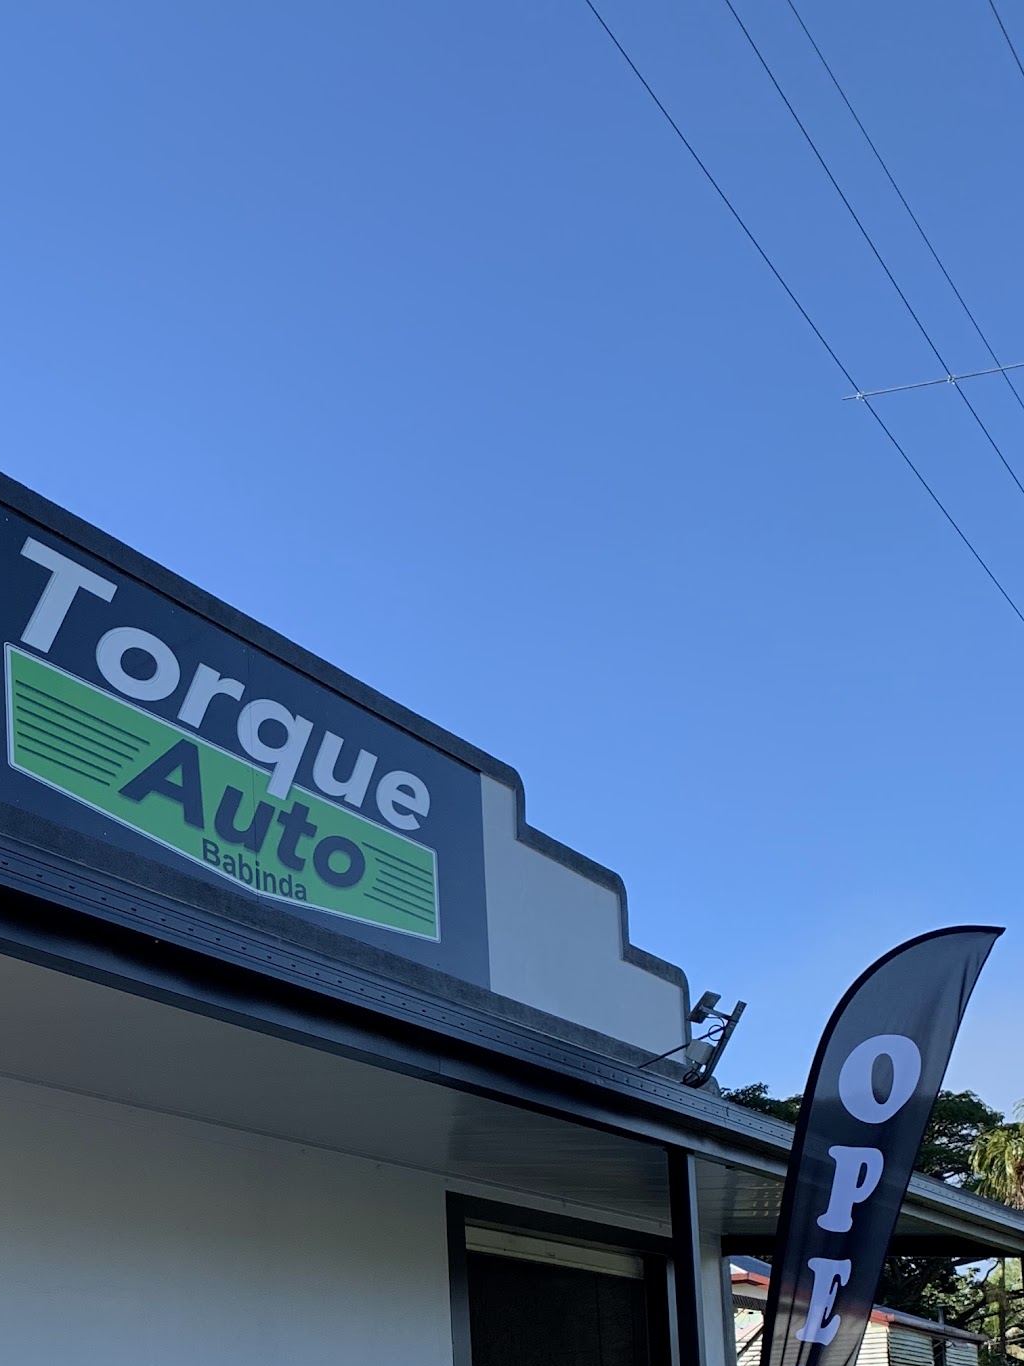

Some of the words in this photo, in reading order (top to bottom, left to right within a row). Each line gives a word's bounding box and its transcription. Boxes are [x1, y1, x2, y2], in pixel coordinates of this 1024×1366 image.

[20, 536, 431, 830] Torque
[117, 738, 366, 888] Auto
[203, 838, 307, 902] Babinda
